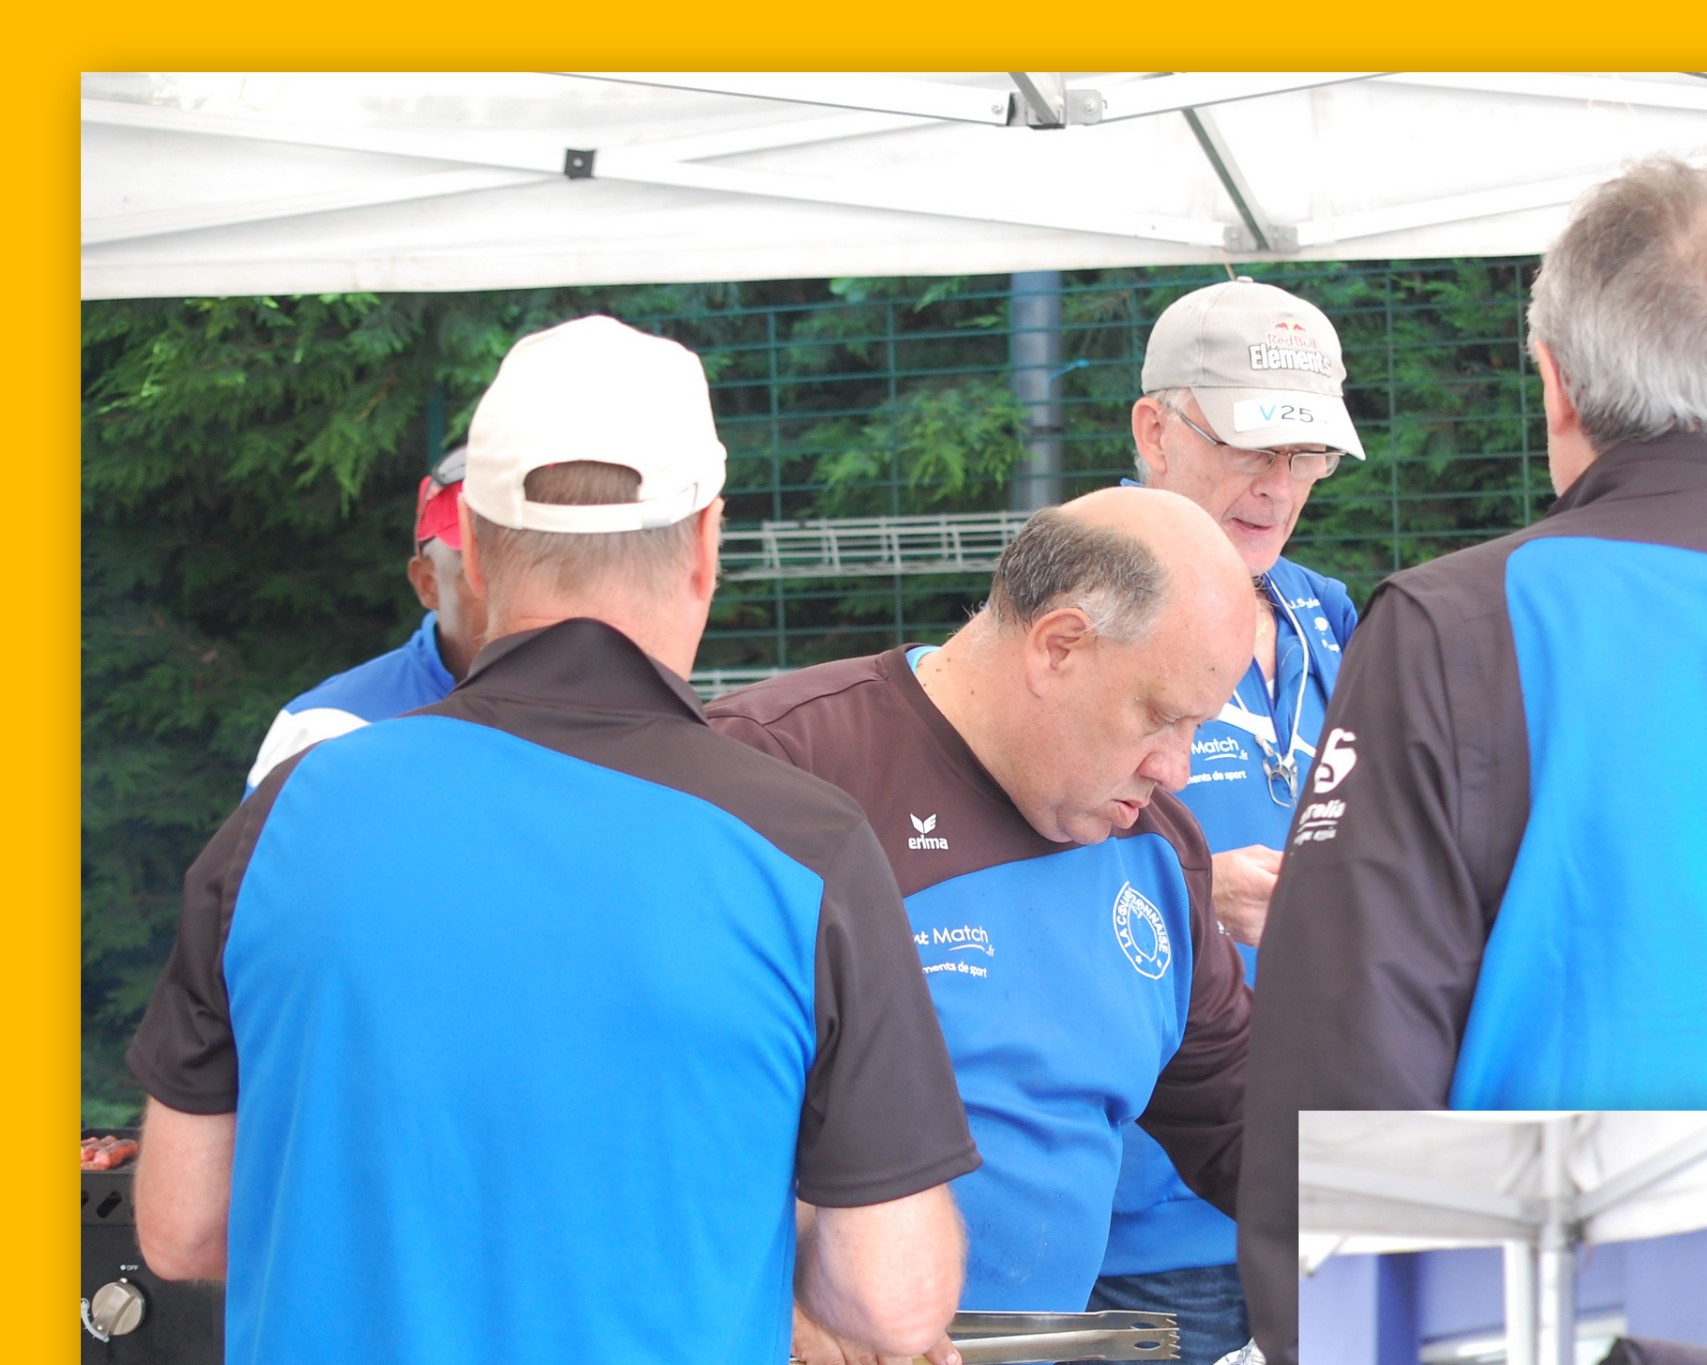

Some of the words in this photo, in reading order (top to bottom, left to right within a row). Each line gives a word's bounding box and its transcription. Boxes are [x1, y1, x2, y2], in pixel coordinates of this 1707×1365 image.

[1249, 343, 1332, 377] Eléments
[1259, 404, 1314, 423] V25
[1190, 737, 1239, 755] Match
[908, 833, 949, 850] erima
[932, 924, 989, 945] Match
[957, 960, 969, 974] de
[969, 965, 988, 979] sport
